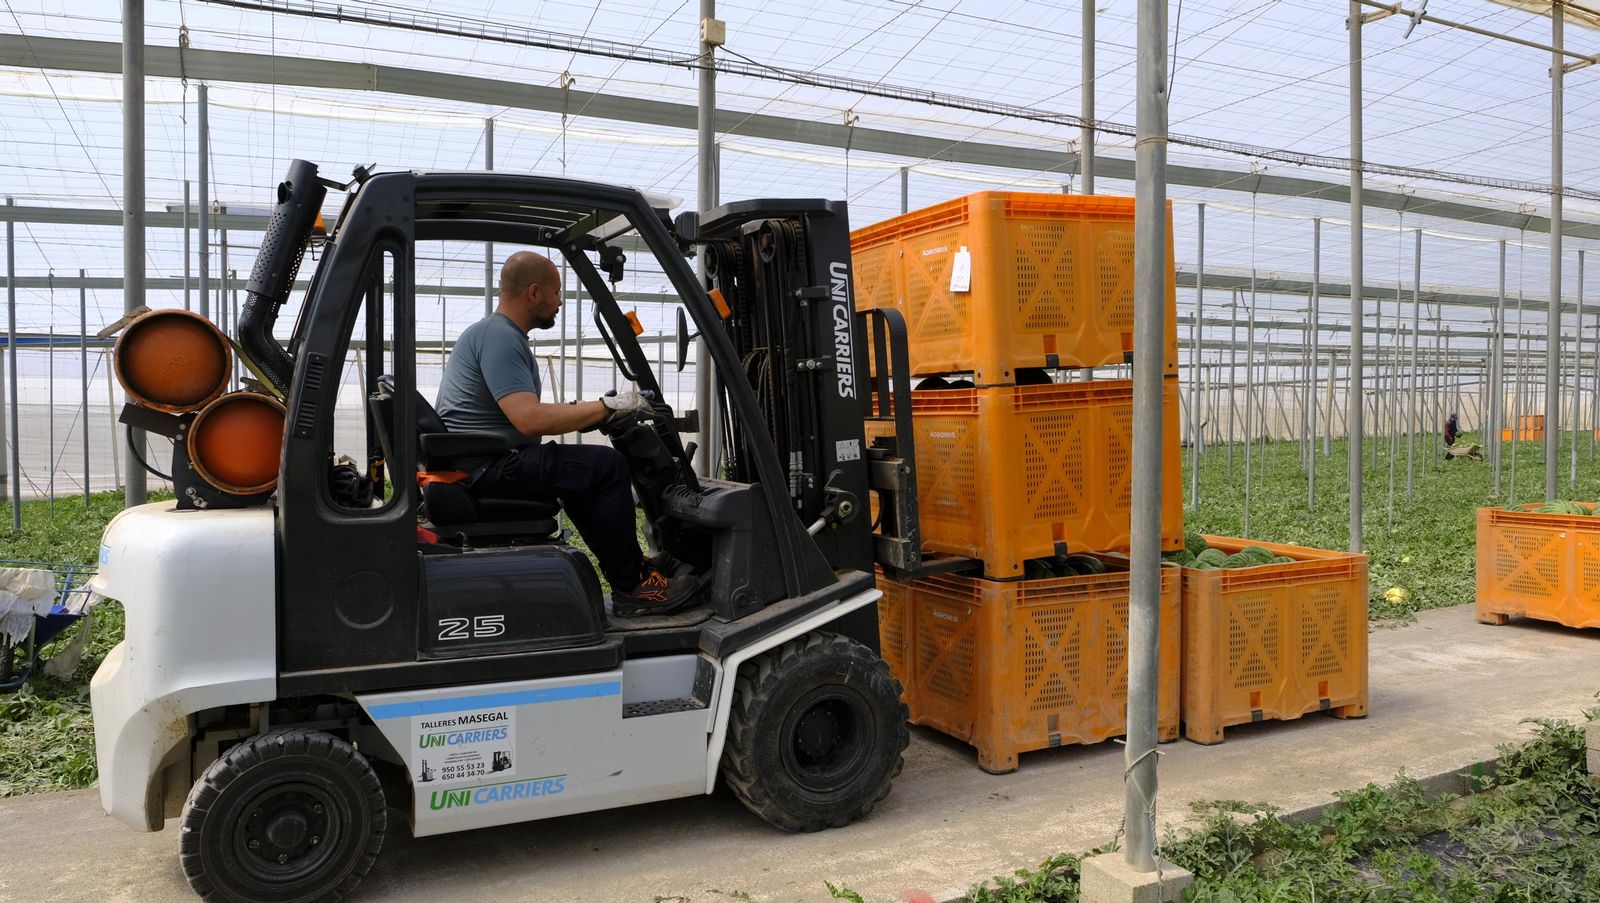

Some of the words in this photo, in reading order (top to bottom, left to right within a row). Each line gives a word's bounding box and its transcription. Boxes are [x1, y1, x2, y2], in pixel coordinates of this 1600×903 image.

[830, 261, 854, 399] UNICARRIERS
[438, 615, 505, 640] 25
[421, 719, 457, 729] TALLERES
[458, 711, 508, 725] MASEGAL
[419, 727, 508, 749] UNICARRIERS
[430, 777, 566, 810] UNICARRIERS
